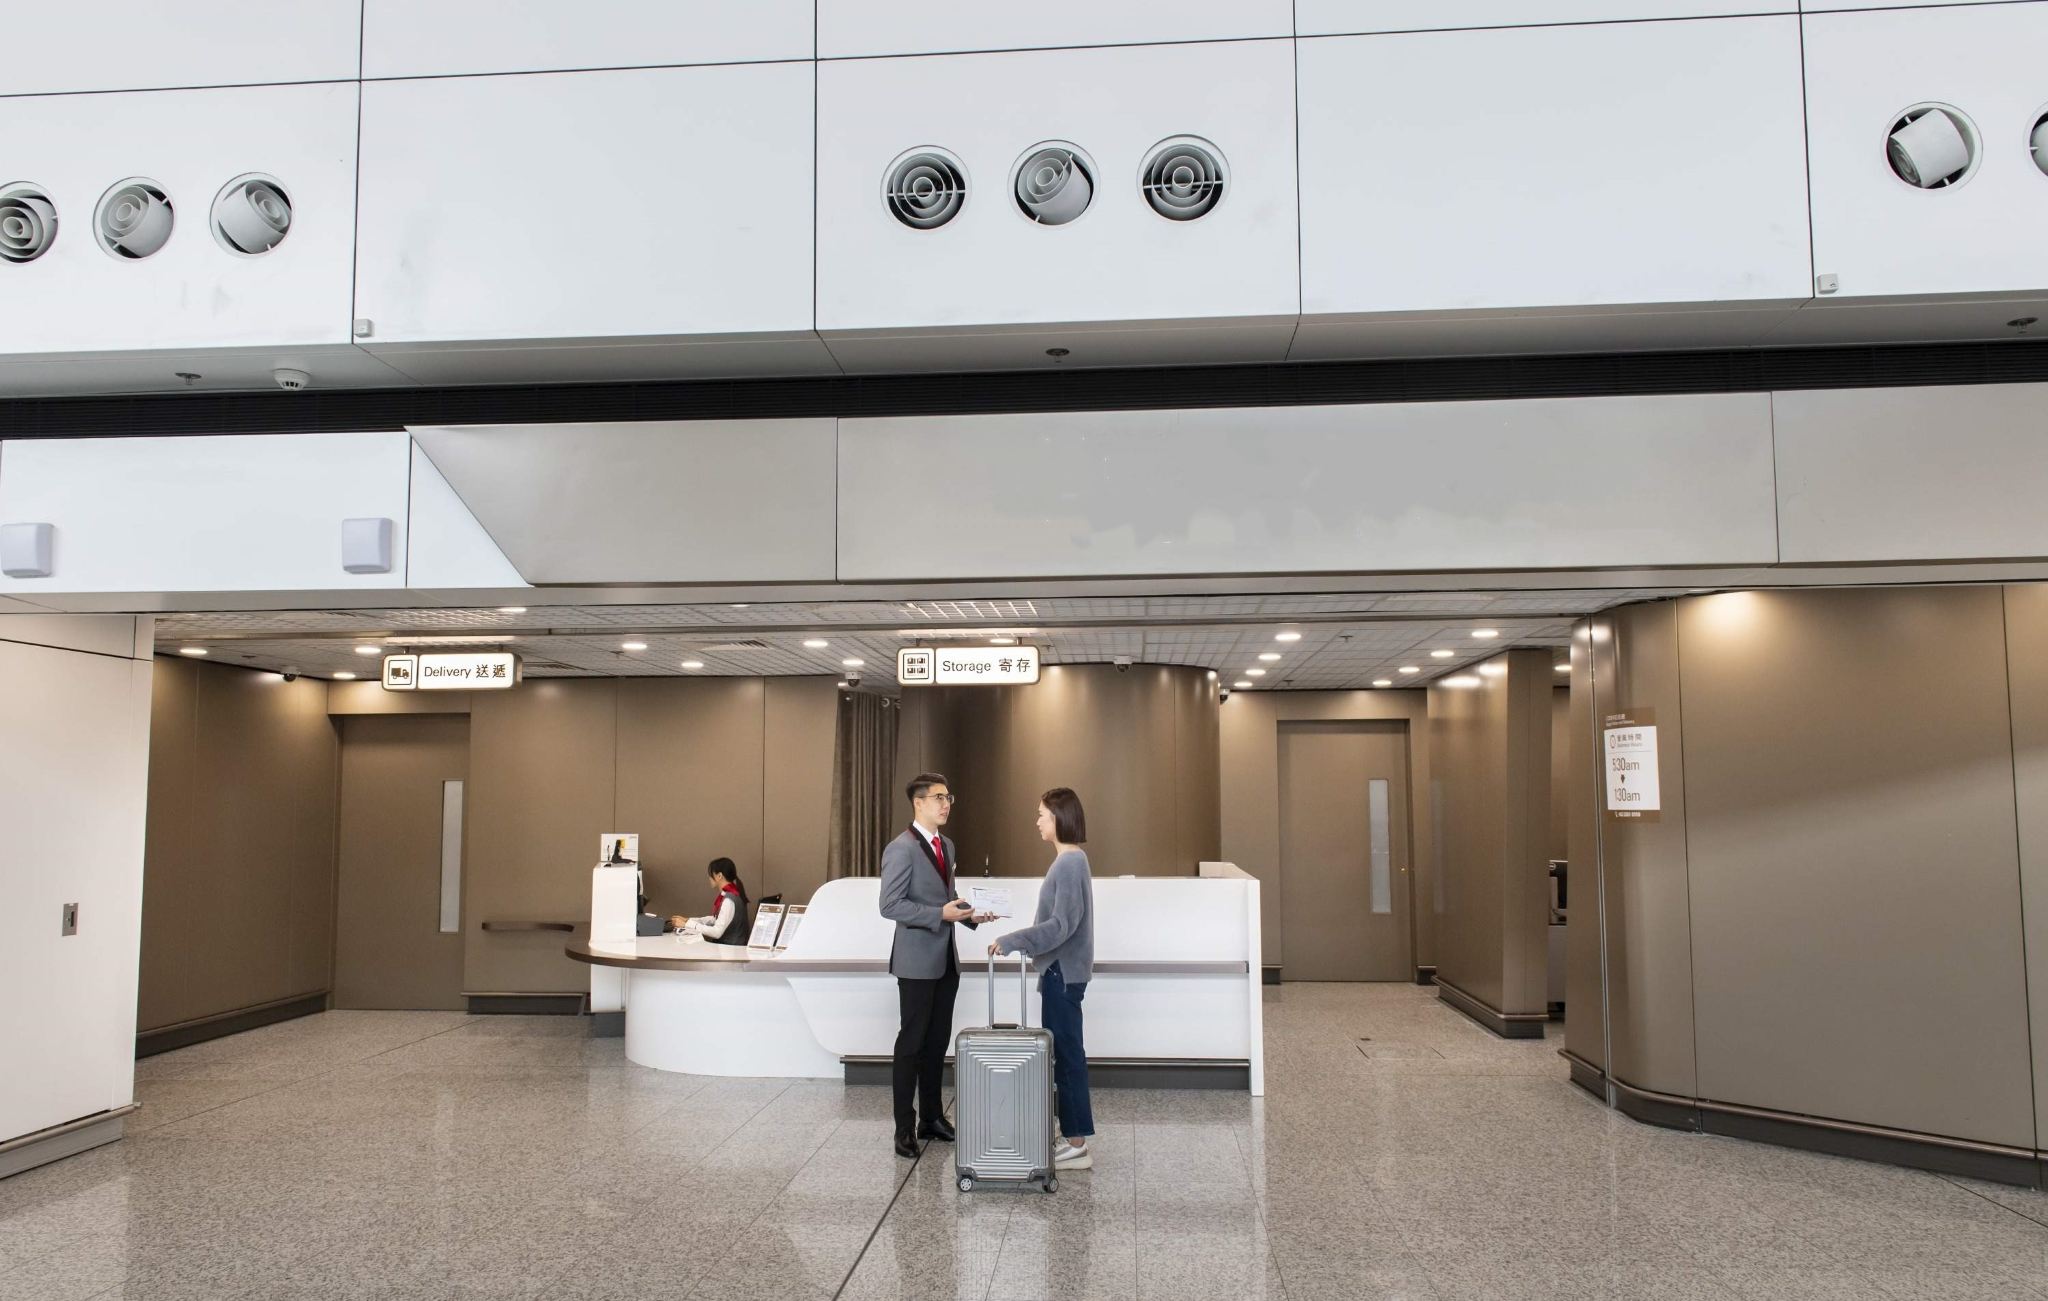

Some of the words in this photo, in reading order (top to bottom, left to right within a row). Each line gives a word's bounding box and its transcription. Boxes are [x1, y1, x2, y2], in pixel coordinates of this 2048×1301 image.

[424, 666, 471, 678] Delivery
[476, 664, 506, 678] 送遞
[942, 660, 991, 673] Storage
[998, 657, 1031, 672] 寄存
